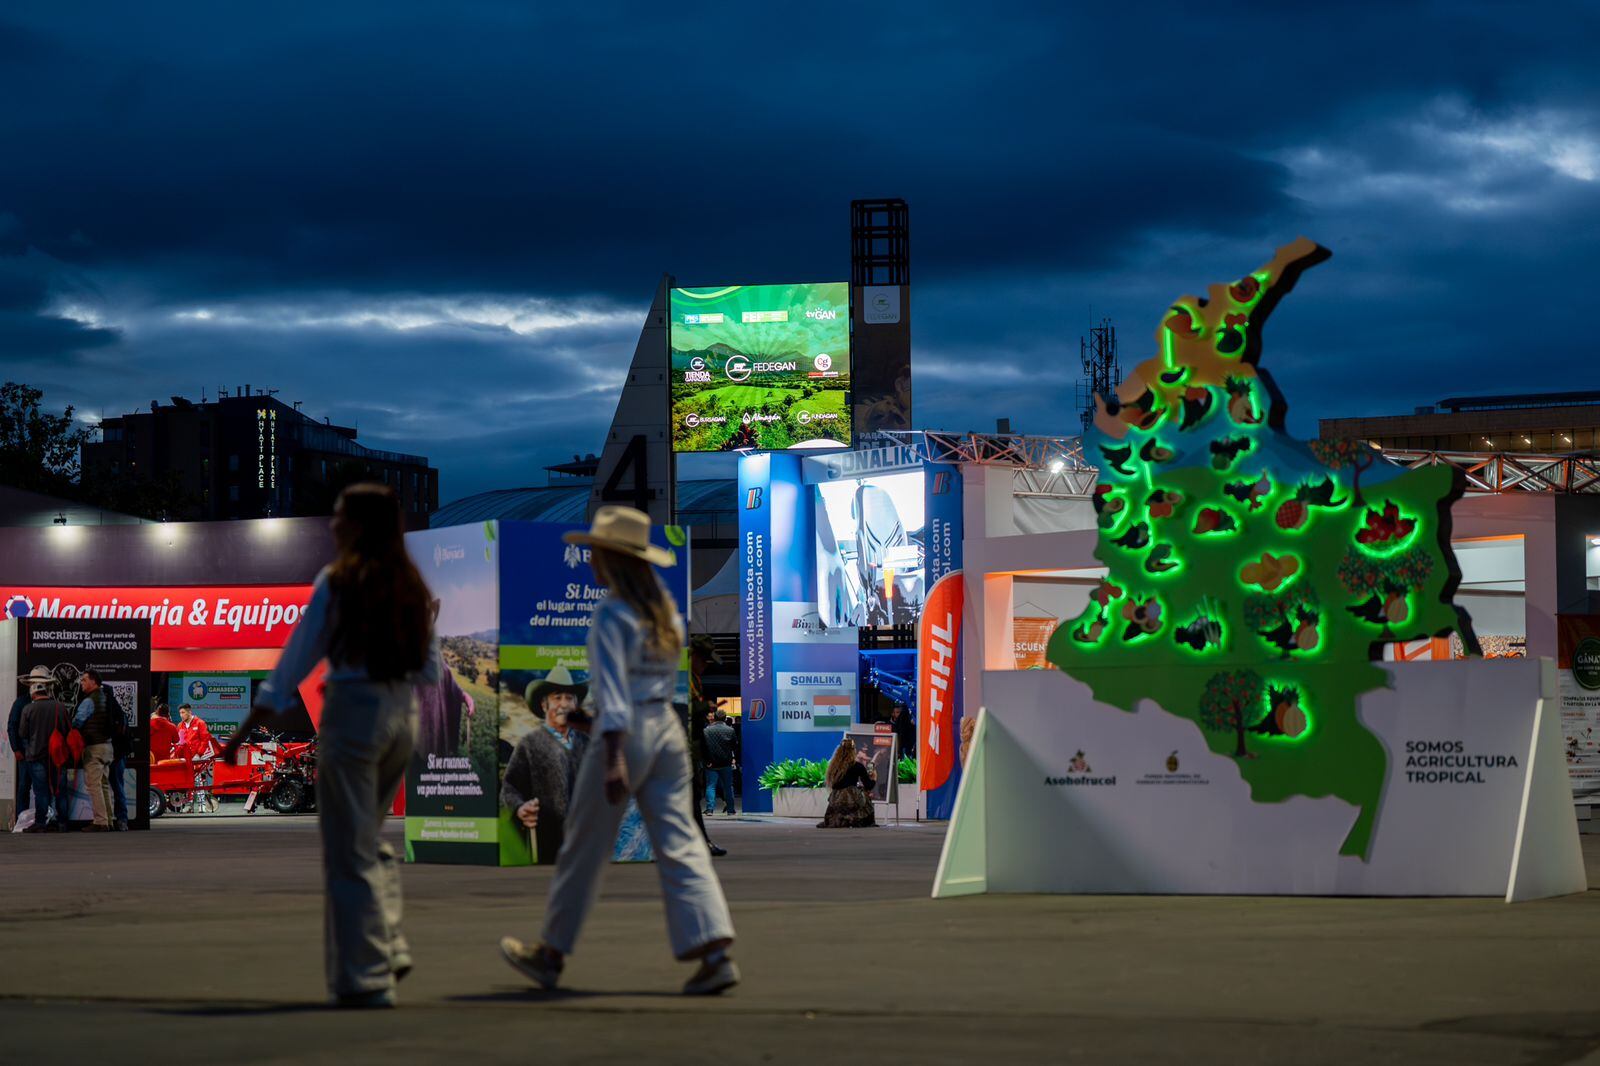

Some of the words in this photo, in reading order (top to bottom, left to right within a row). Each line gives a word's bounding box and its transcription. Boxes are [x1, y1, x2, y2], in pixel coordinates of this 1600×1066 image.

[752, 361, 796, 372] FEDEGAN
[827, 442, 925, 479] SONALIKA
[601, 434, 656, 513] 4
[565, 583, 582, 600] Si
[583, 584, 609, 600] bus
[187, 598, 208, 626] &
[536, 600, 546, 611] el
[548, 599, 575, 613] lugar
[746, 531, 756, 684] www.diskubota.com
[755, 534, 764, 679] www.bimercol.com
[530, 615, 550, 627] del
[32, 629, 91, 640] INSCRÍBETE
[113, 632, 128, 640] parte
[57, 642, 75, 650] grupo
[85, 641, 138, 650] INVITADOS
[1013, 642, 1047, 652] ESCUEN
[790, 675, 842, 686] SONALIKA
[928, 612, 953, 755] STIHL
[781, 710, 812, 720] INDIA
[1405, 740, 1464, 754] SOMOS
[443, 757, 472, 771] ruanas,
[1405, 755, 1518, 768] AGRICULTURA
[1044, 776, 1117, 786] Asohofrucol
[1405, 770, 1486, 784] TROPICAL
[425, 785, 437, 797] por
[437, 783, 454, 796] buen
[454, 783, 483, 796] camino.
